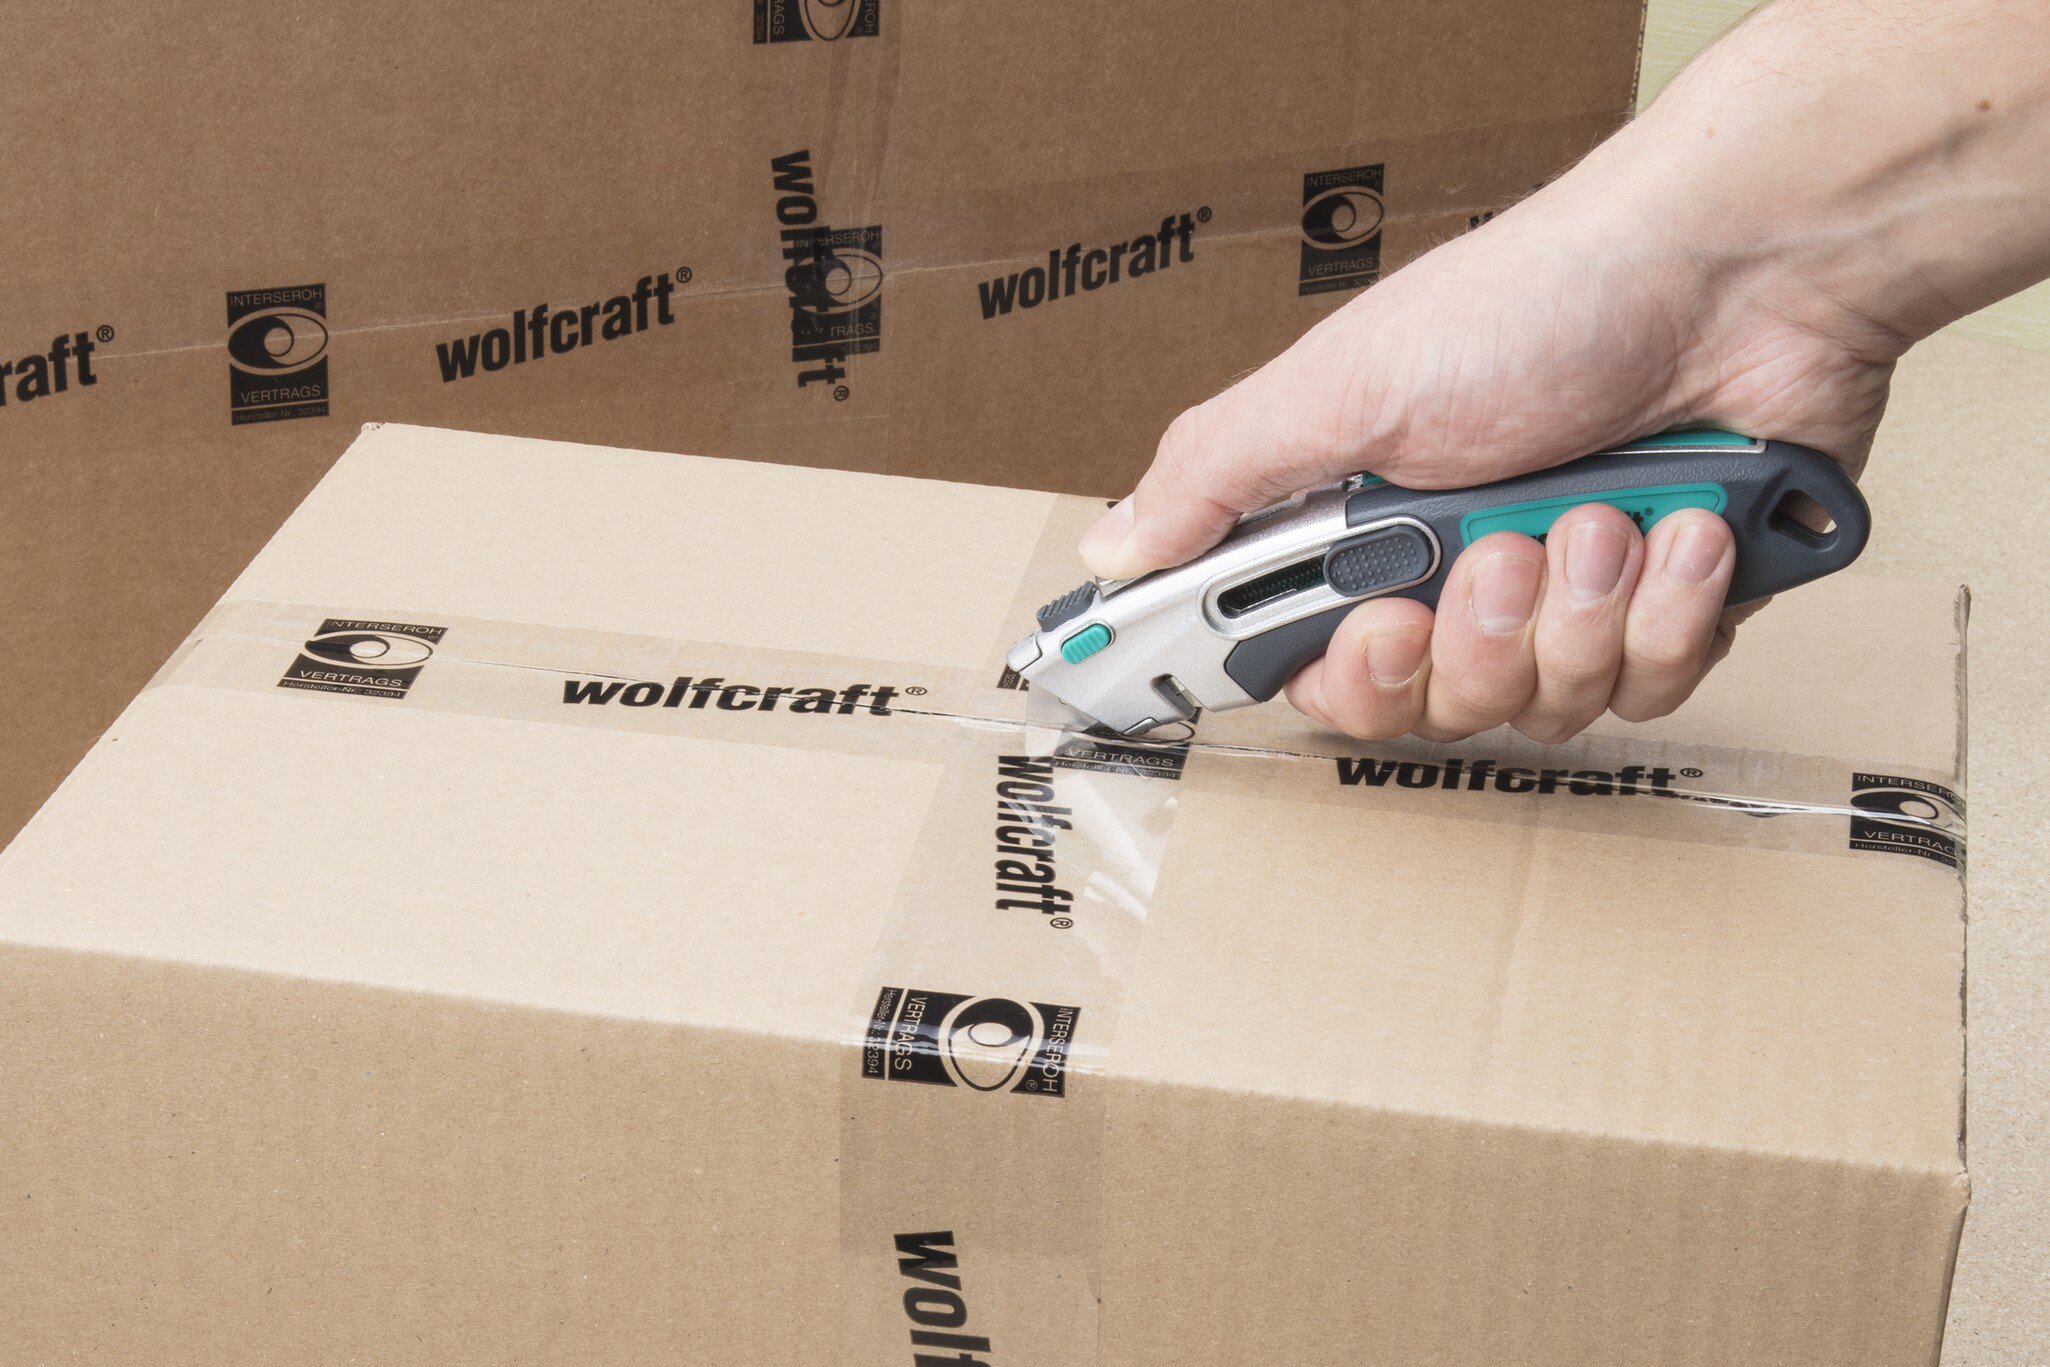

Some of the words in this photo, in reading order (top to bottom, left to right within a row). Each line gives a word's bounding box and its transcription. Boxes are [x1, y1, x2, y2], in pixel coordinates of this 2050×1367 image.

[1306, 168, 1381, 187] INTERSEROH
[797, 229, 879, 248] INERSEROH
[1308, 256, 1374, 276] VERTRAGS
[230, 287, 322, 307] INTERSEROH
[240, 384, 321, 404] VERTRAGS
[326, 620, 443, 635] INTERSEROH
[299, 670, 403, 687] VERTRAGS
[1068, 748, 1174, 767] VERTRAGS
[894, 997, 928, 1071] VERTRAGS
[1042, 1007, 1074, 1092] INTERSEROH
